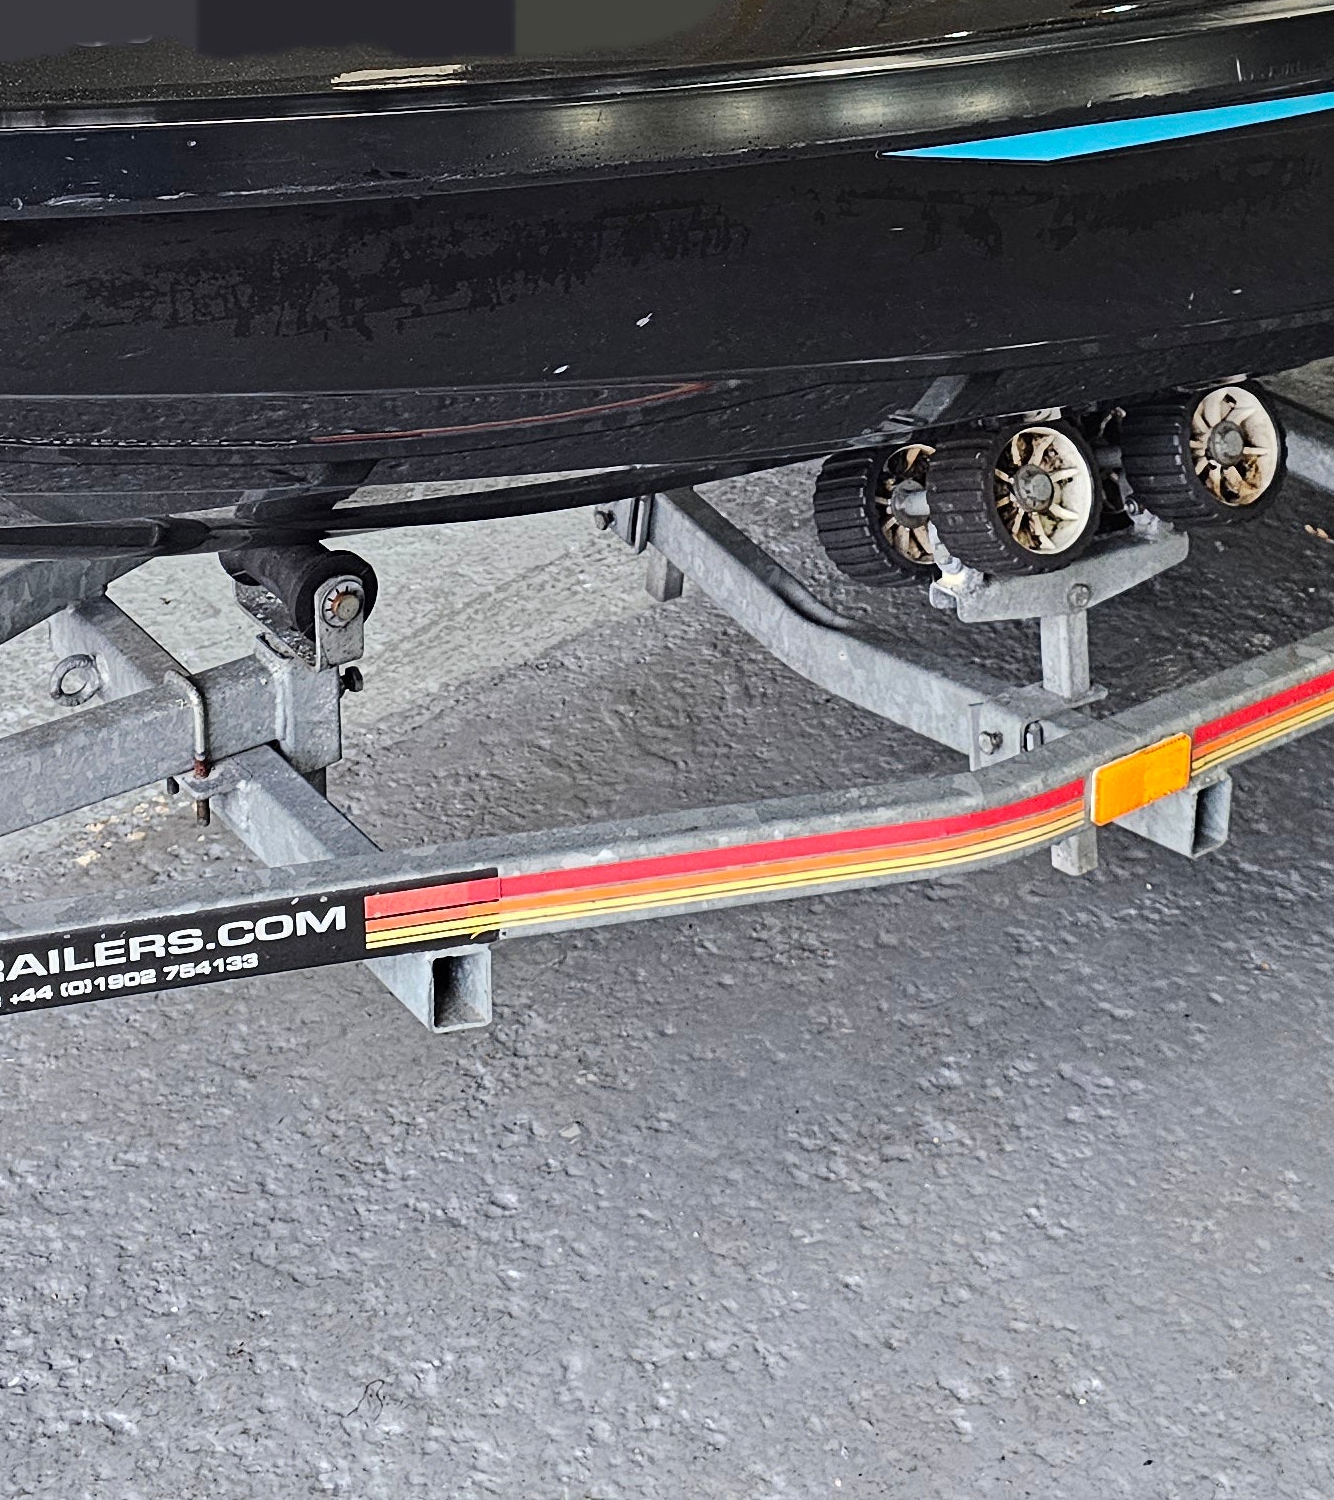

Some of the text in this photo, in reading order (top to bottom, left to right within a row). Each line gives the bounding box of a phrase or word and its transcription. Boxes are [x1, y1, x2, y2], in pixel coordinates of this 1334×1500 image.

[9, 986, 54, 1006] +44
[59, 967, 157, 999] (0)1902
[163, 952, 259, 982] 754133
